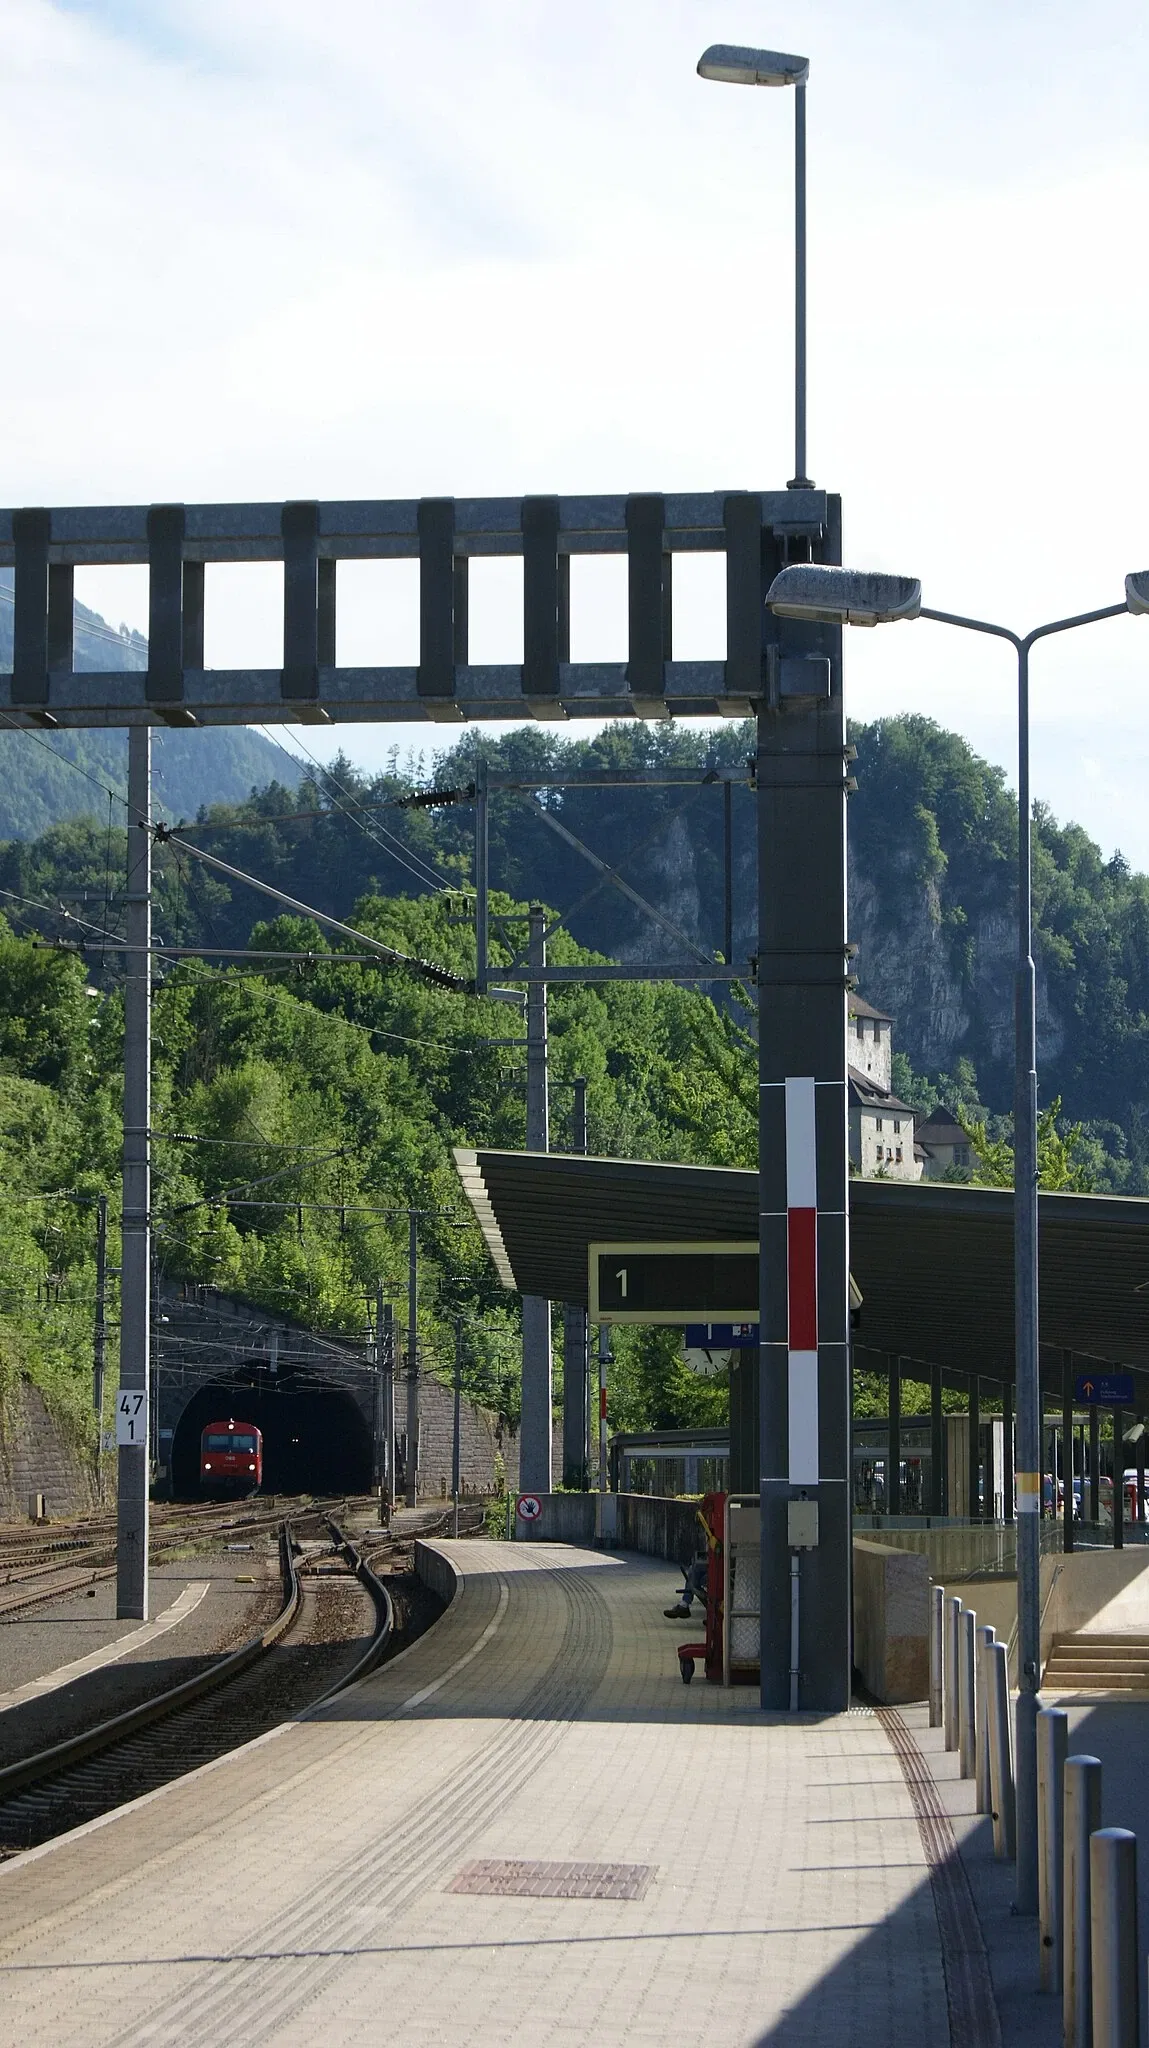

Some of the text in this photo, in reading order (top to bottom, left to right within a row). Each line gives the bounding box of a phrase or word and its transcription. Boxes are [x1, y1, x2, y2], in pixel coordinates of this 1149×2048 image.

[615, 1269, 628, 1297] 1
[120, 1395, 143, 1415] 47
[128, 1420, 134, 1440] 1
